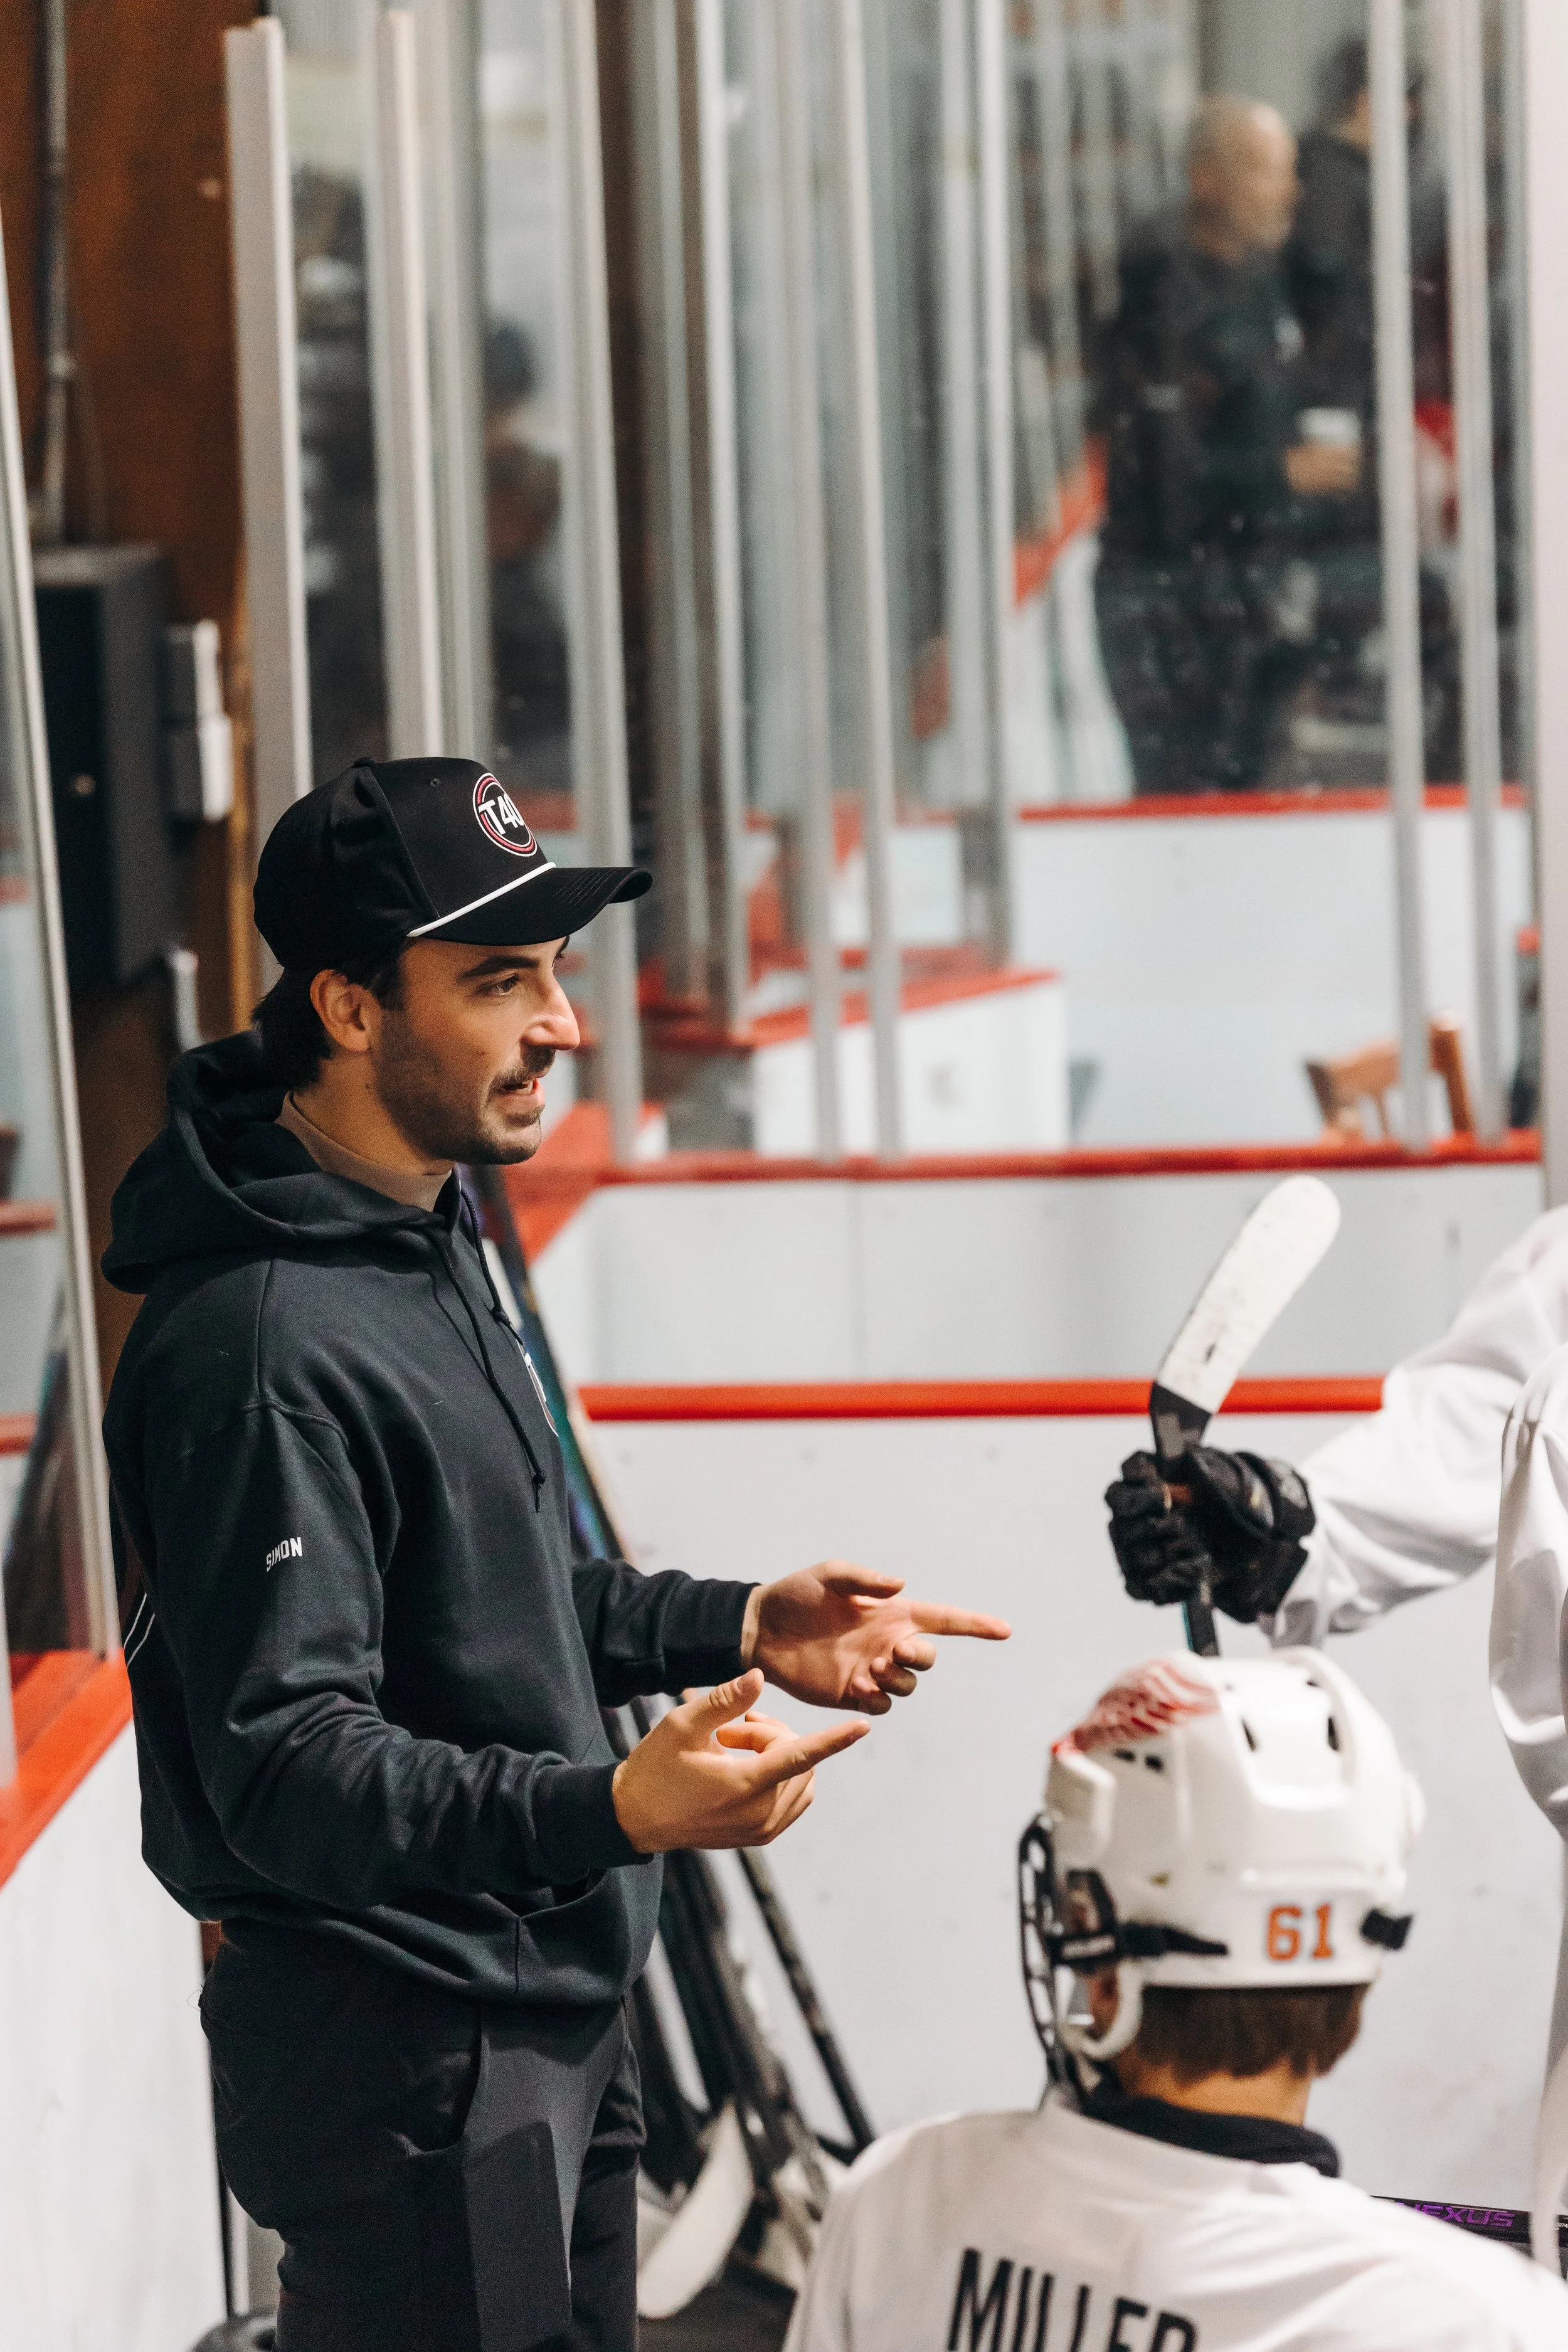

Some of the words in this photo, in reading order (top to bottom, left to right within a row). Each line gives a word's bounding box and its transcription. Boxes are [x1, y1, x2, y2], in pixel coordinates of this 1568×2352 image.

[478, 793, 524, 835] T40
[266, 1537, 302, 1572] SIMON
[1267, 1903, 1333, 1961] 61
[1396, 2202, 1515, 2227] EXUS
